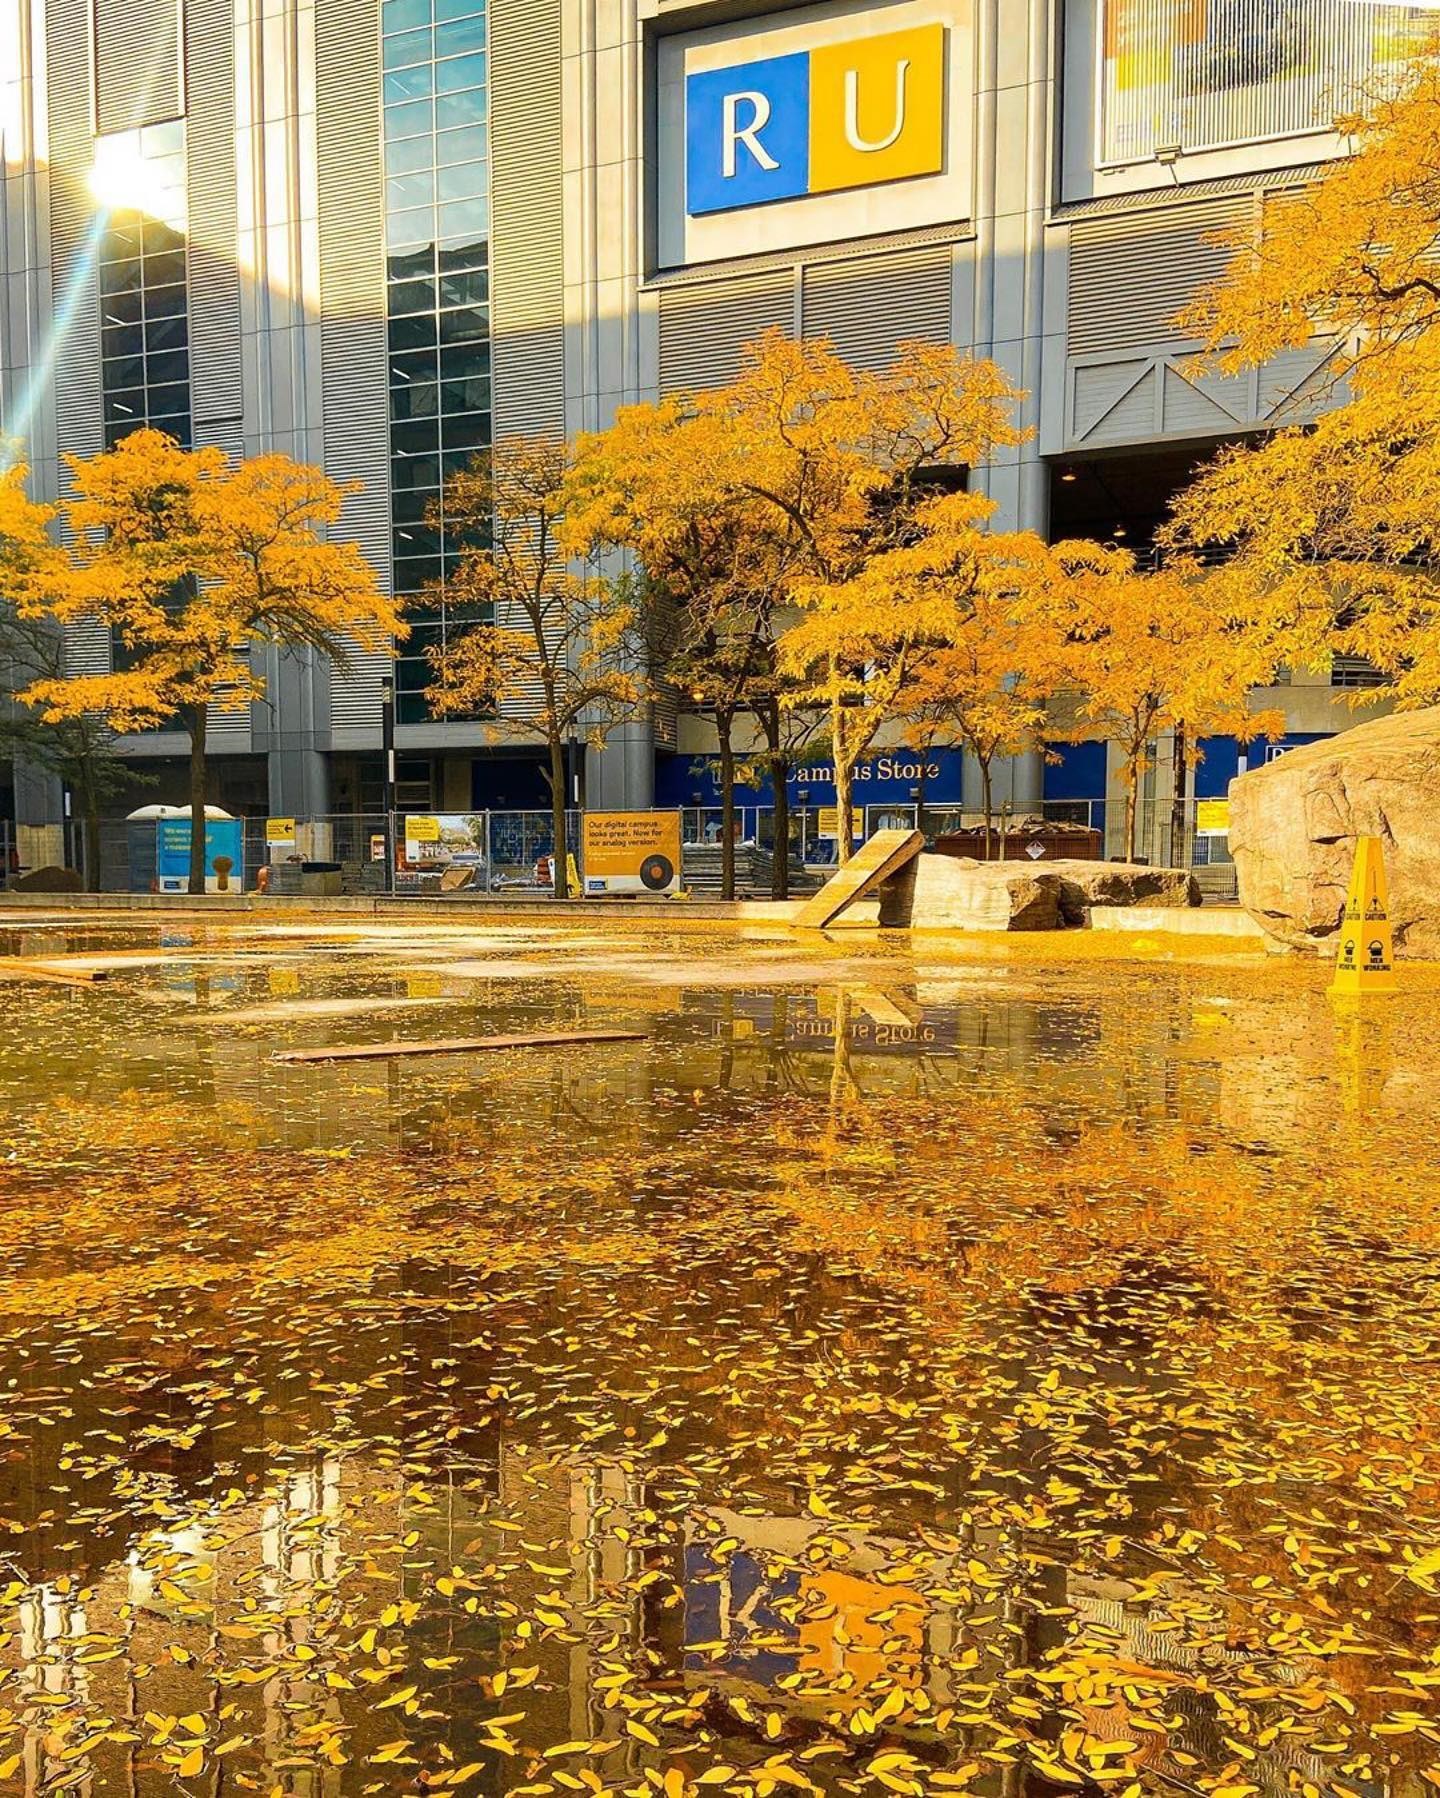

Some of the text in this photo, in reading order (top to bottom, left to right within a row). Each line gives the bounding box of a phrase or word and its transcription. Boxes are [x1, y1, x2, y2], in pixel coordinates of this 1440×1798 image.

[877, 758, 940, 780] Store
[604, 820, 627, 829] digital
[628, 820, 658, 829] campus
[602, 839, 626, 847] analog
